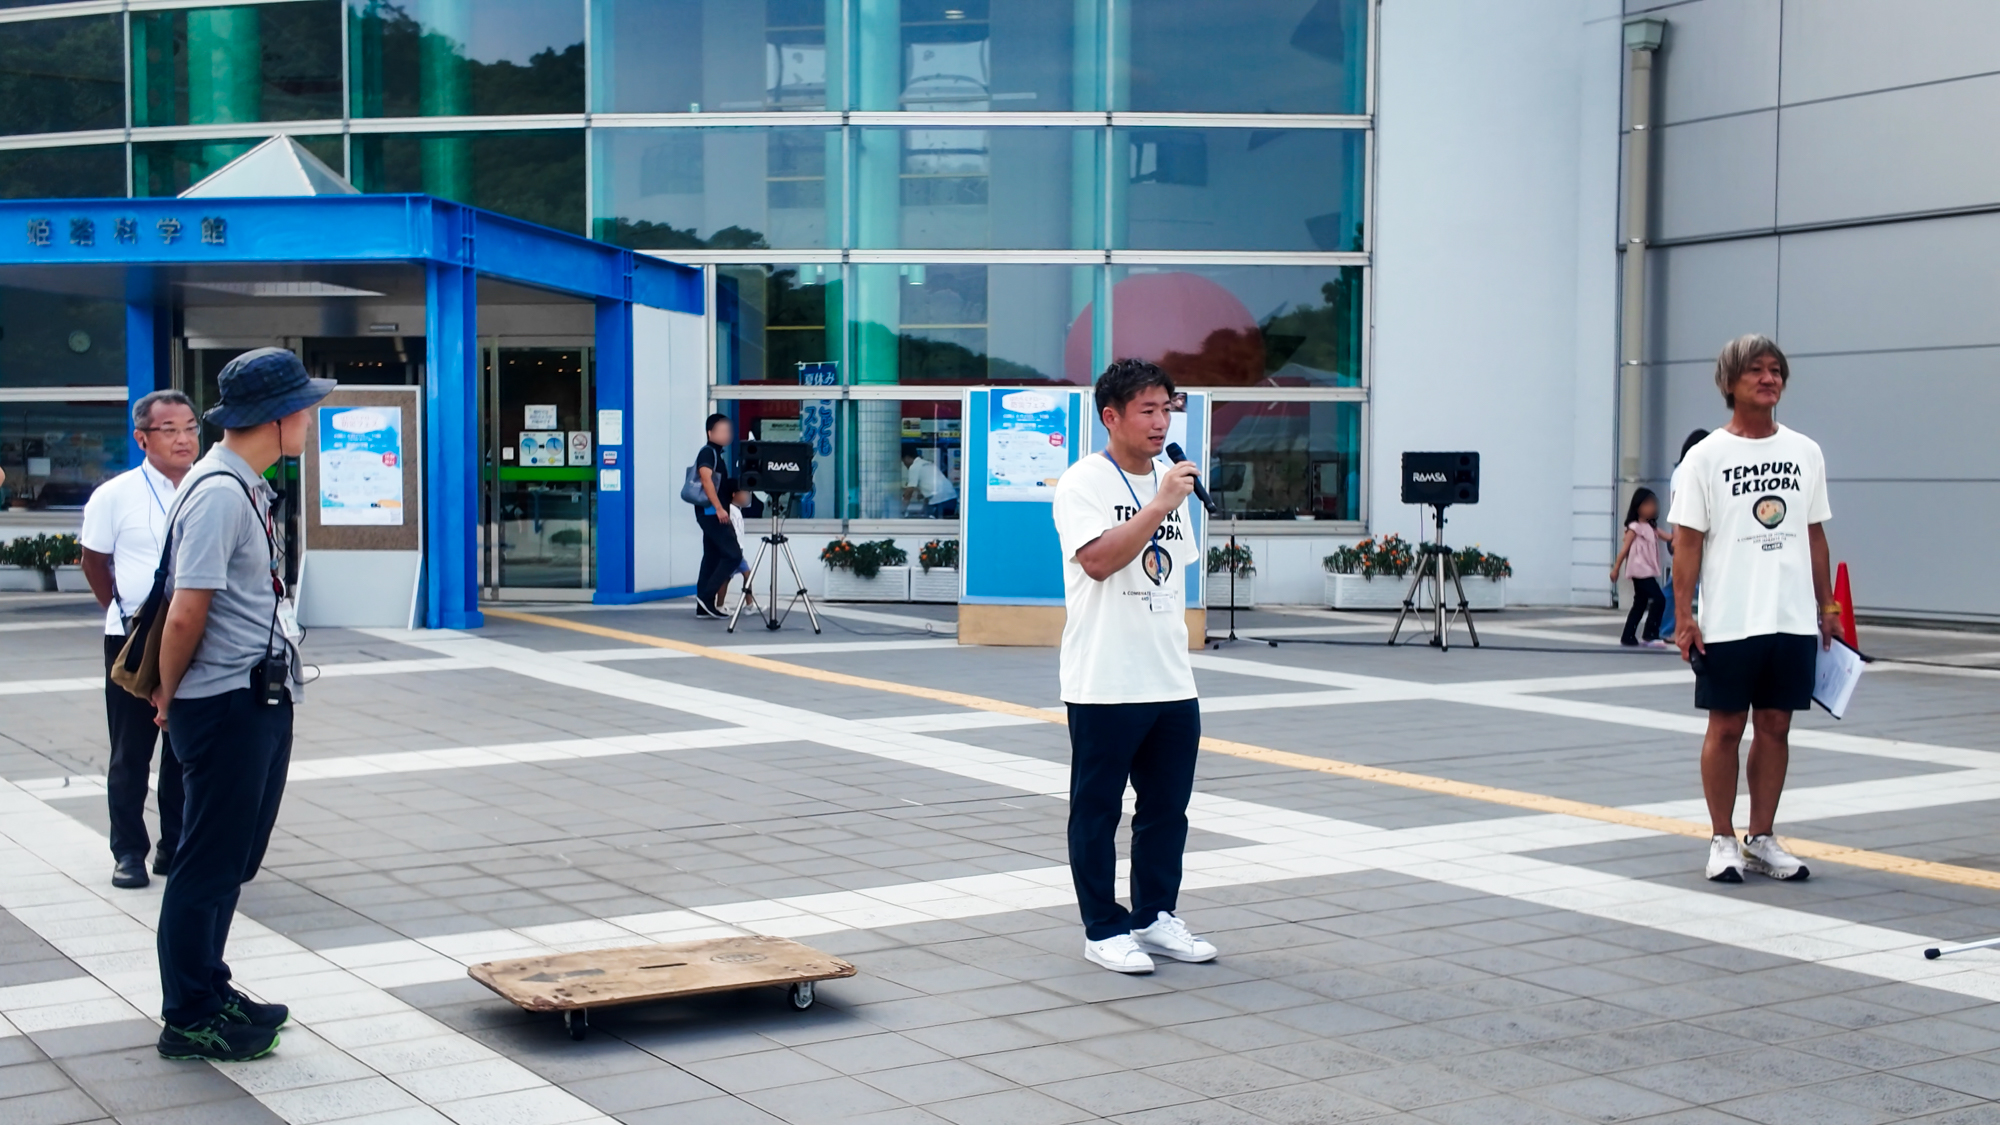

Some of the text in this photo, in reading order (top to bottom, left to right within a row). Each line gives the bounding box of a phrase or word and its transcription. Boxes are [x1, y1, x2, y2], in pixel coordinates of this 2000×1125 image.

[27, 218, 226, 246] 姫路科学館
[804, 371, 835, 385] 夏休み
[768, 461, 800, 472] RAMSA
[1722, 461, 1802, 483] TEMPURA
[1412, 471, 1448, 483] RAMSA
[1732, 477, 1801, 497] EKISOBA
[1114, 505, 1182, 523] TERA
